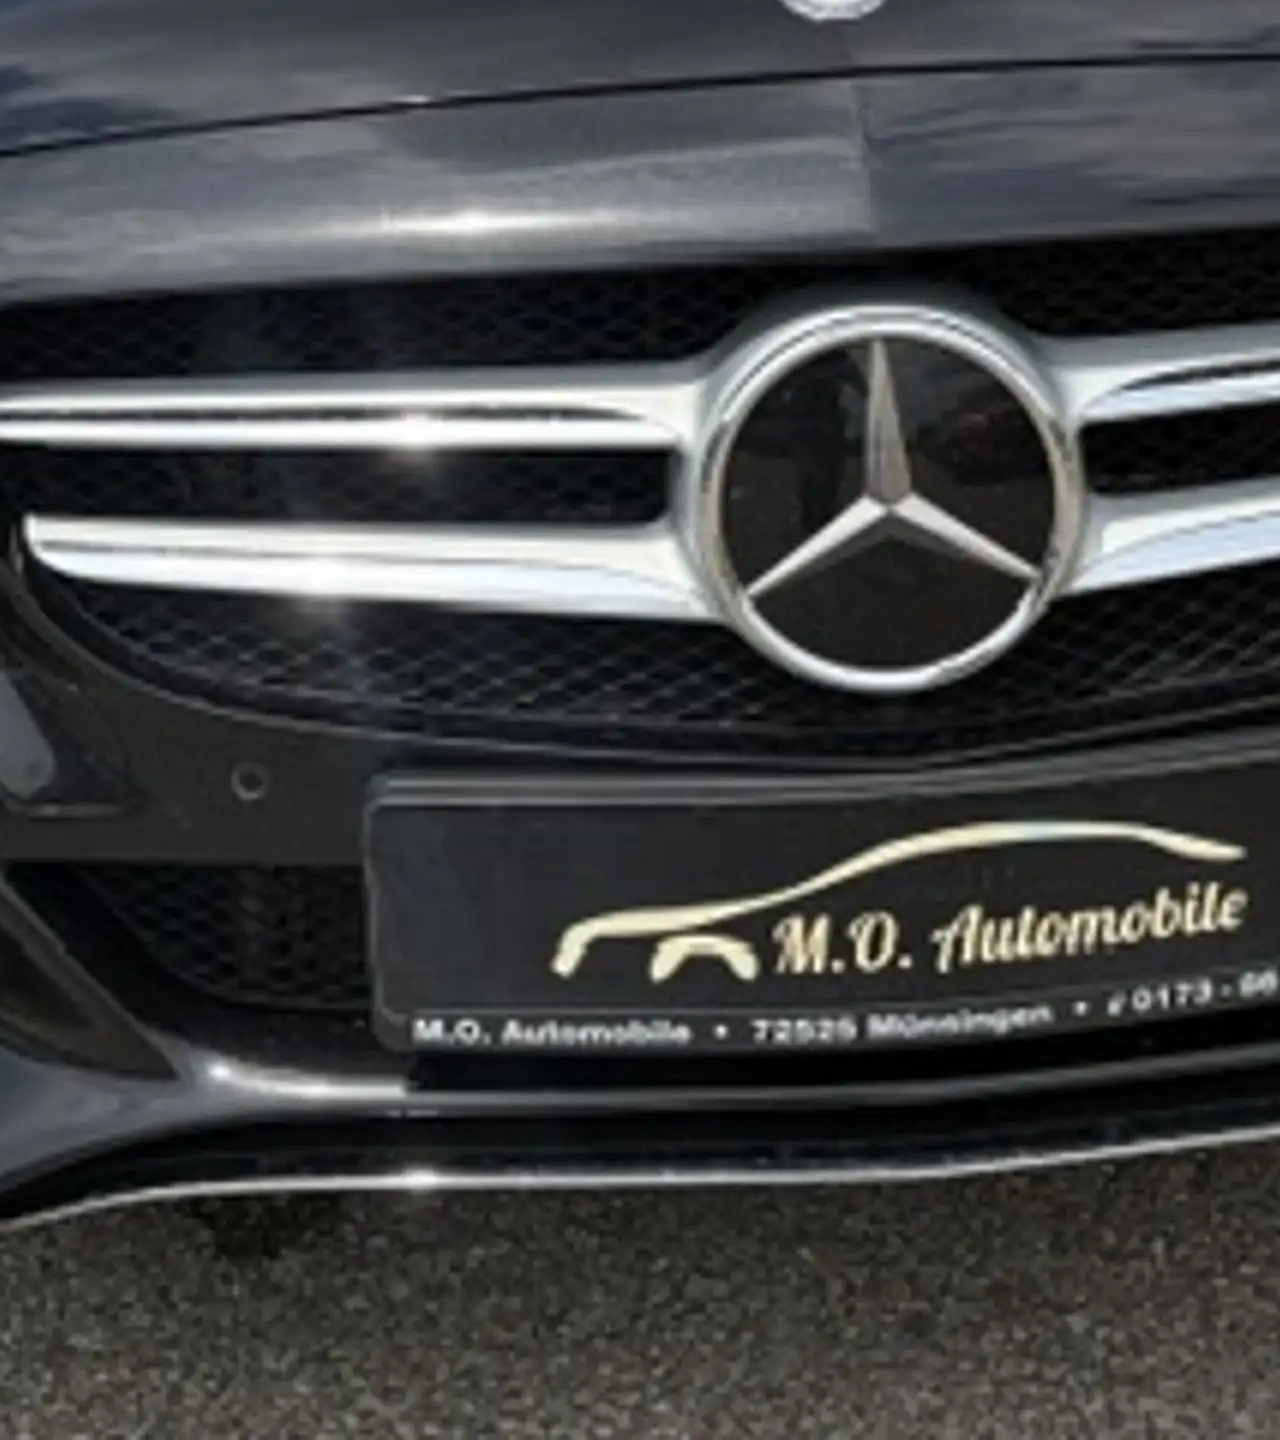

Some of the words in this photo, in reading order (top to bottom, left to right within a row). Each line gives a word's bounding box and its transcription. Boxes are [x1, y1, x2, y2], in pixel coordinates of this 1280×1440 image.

[772, 911, 913, 974] M.O.
[930, 881, 1248, 974] Automobile
[414, 1019, 491, 1046] M.O.
[501, 1019, 692, 1048] Automobile
